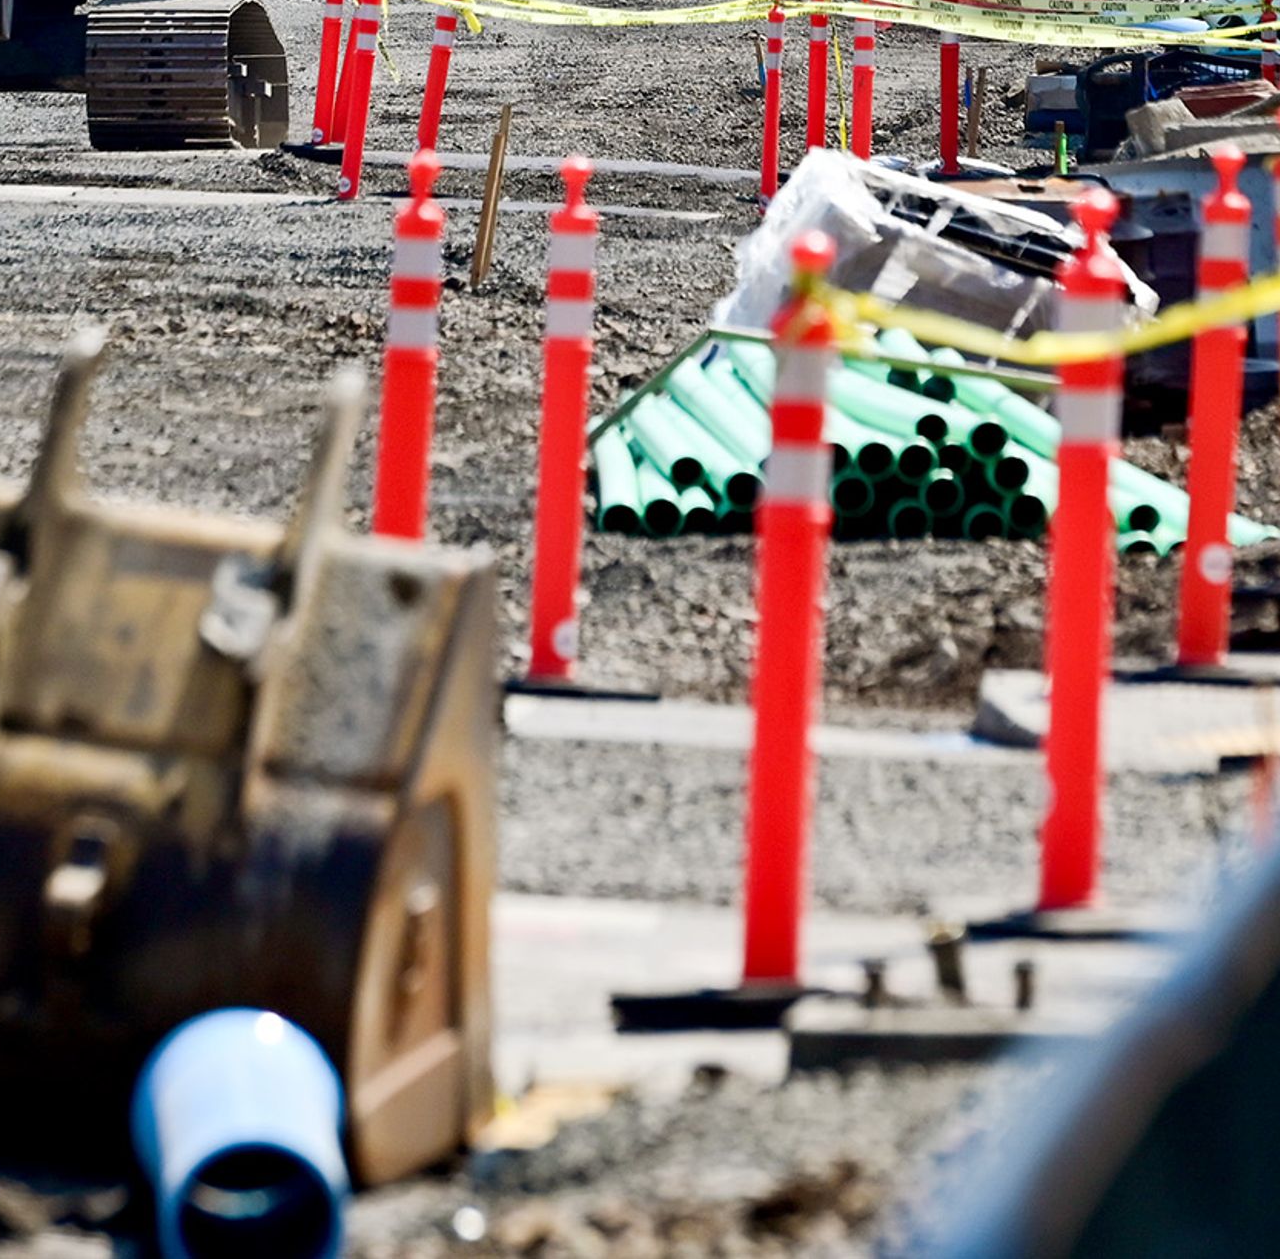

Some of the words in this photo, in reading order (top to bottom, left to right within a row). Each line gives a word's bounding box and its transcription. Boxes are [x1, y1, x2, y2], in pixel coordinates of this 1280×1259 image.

[1049, 0, 1073, 9] CAUTION
[1101, 3, 1127, 11] CAUTION
[1155, 4, 1179, 13] CAUTION
